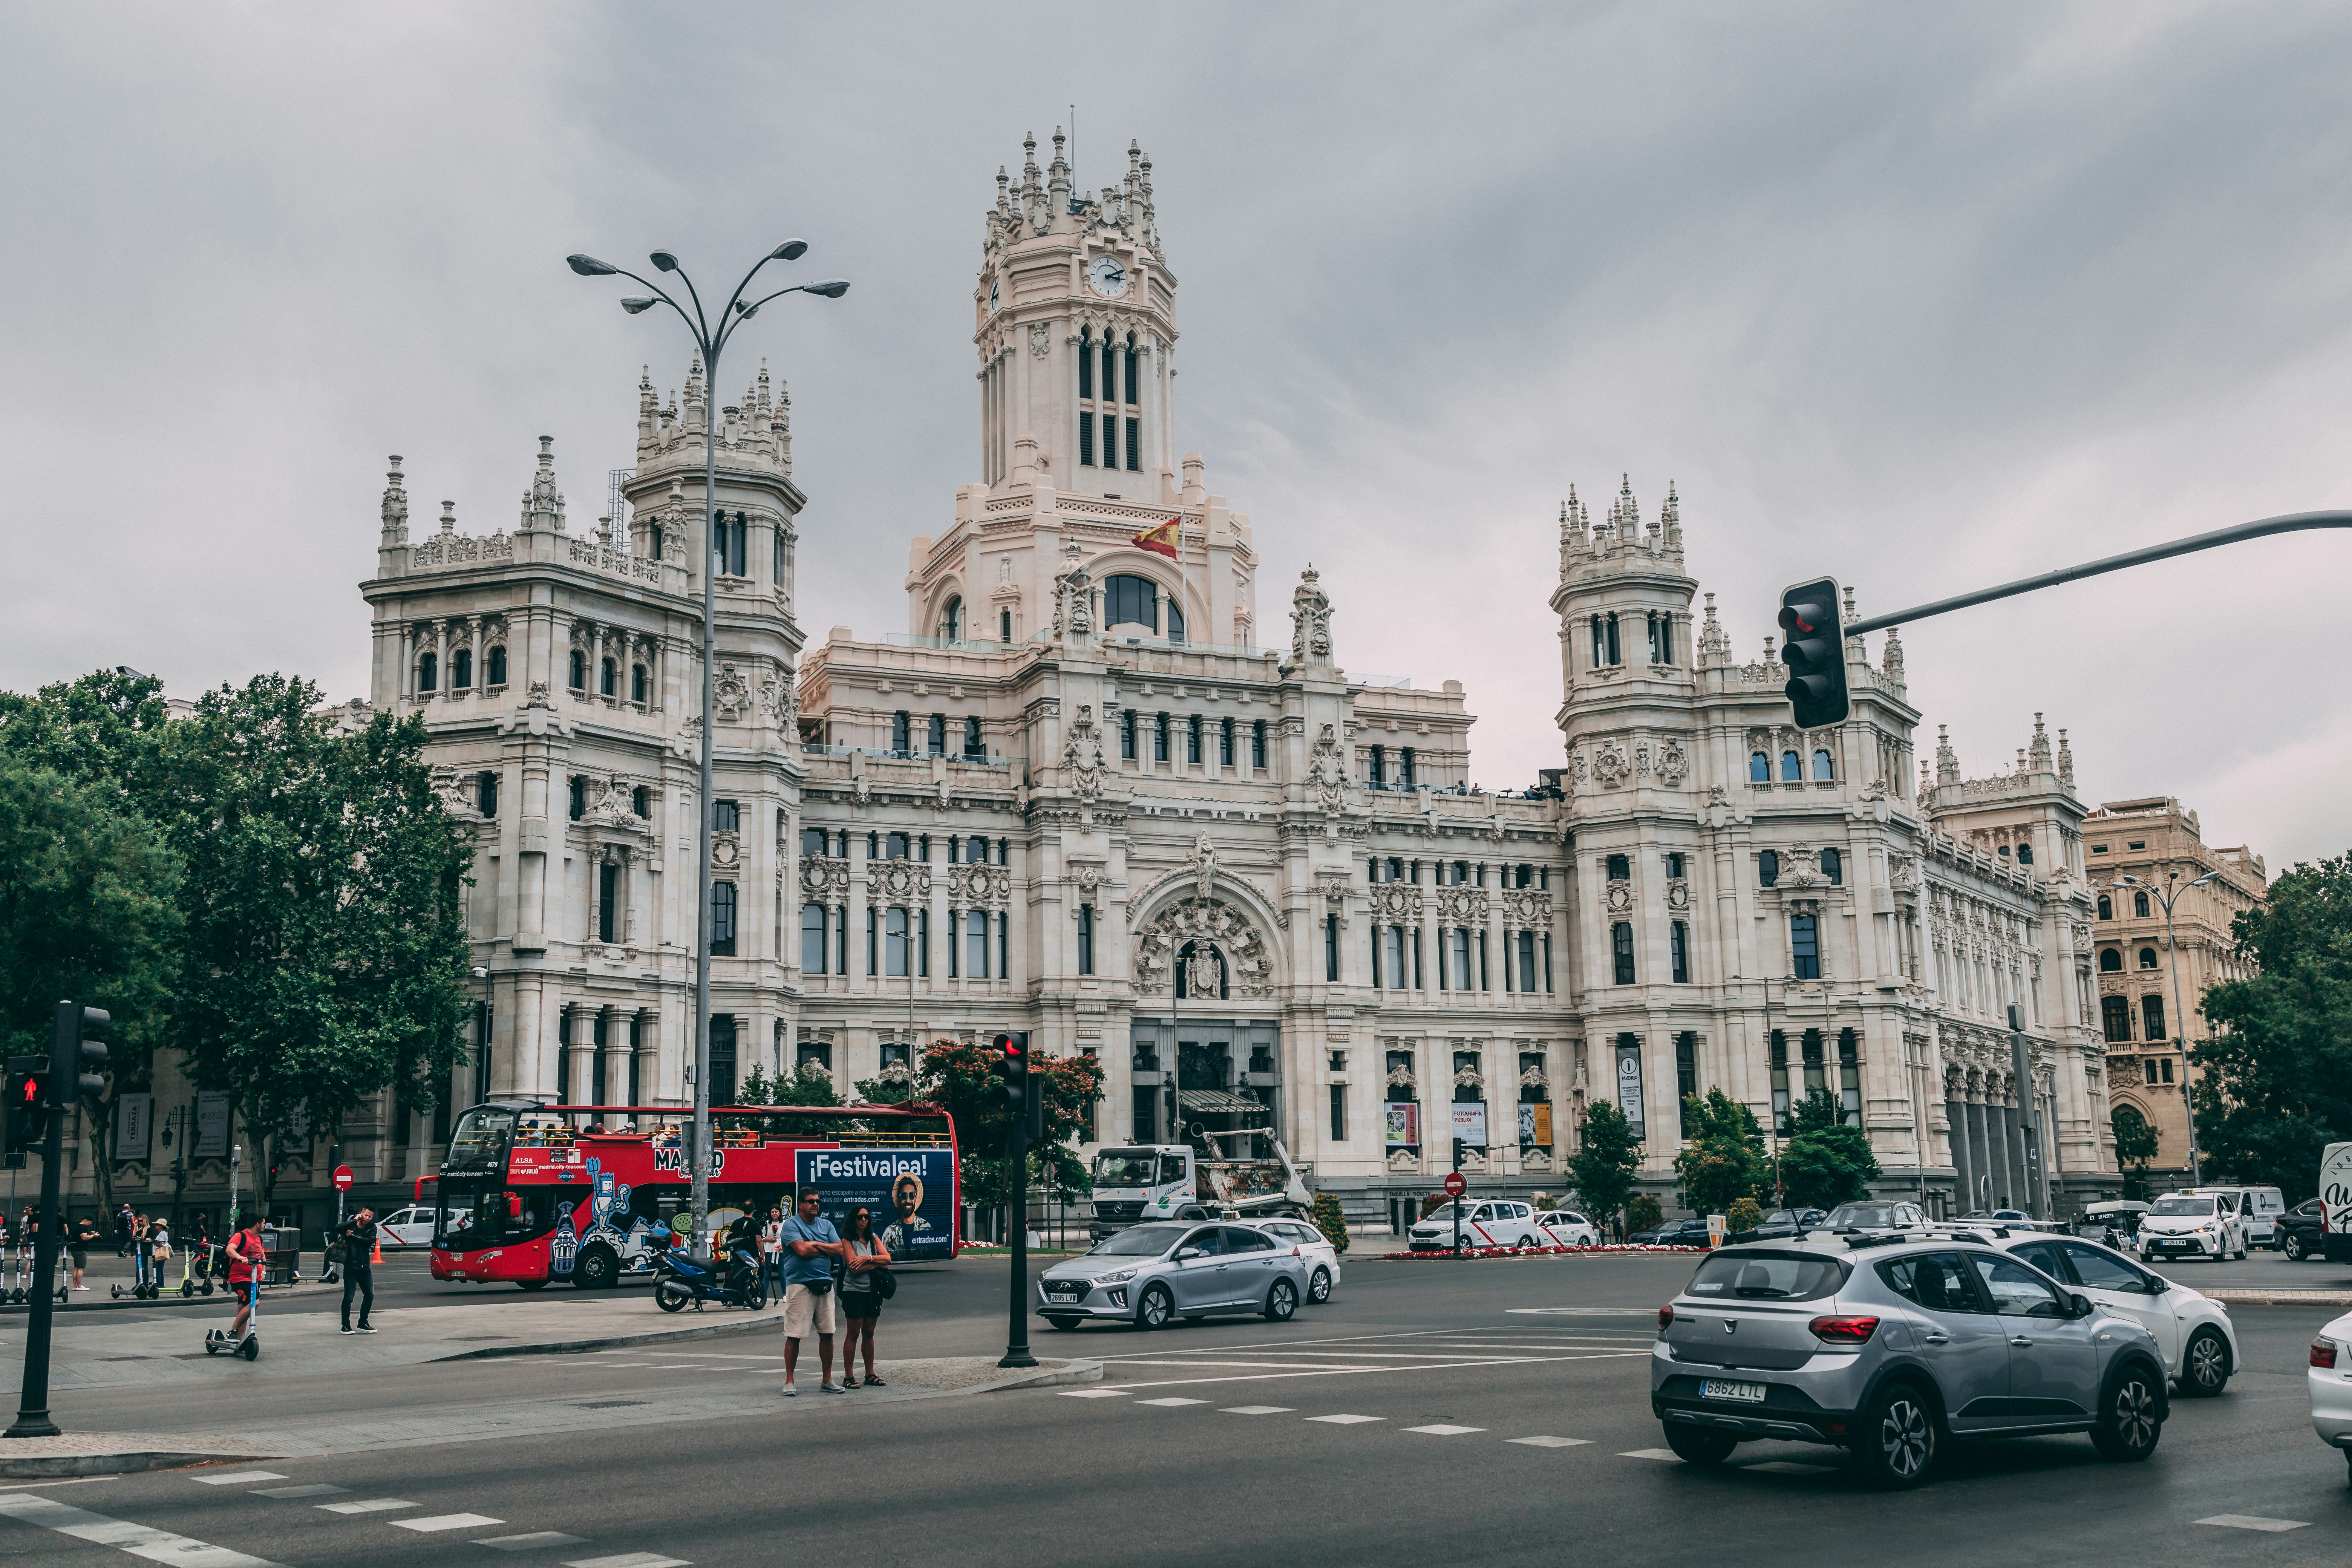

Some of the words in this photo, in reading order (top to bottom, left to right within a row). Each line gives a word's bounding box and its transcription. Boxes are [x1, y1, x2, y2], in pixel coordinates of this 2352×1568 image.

[810, 1155, 927, 1182] ¡Festivalea!
[912, 1236, 947, 1244] entradas.com
[1707, 1381, 1736, 1395] 6862
[1739, 1383, 1761, 1398] LTL
